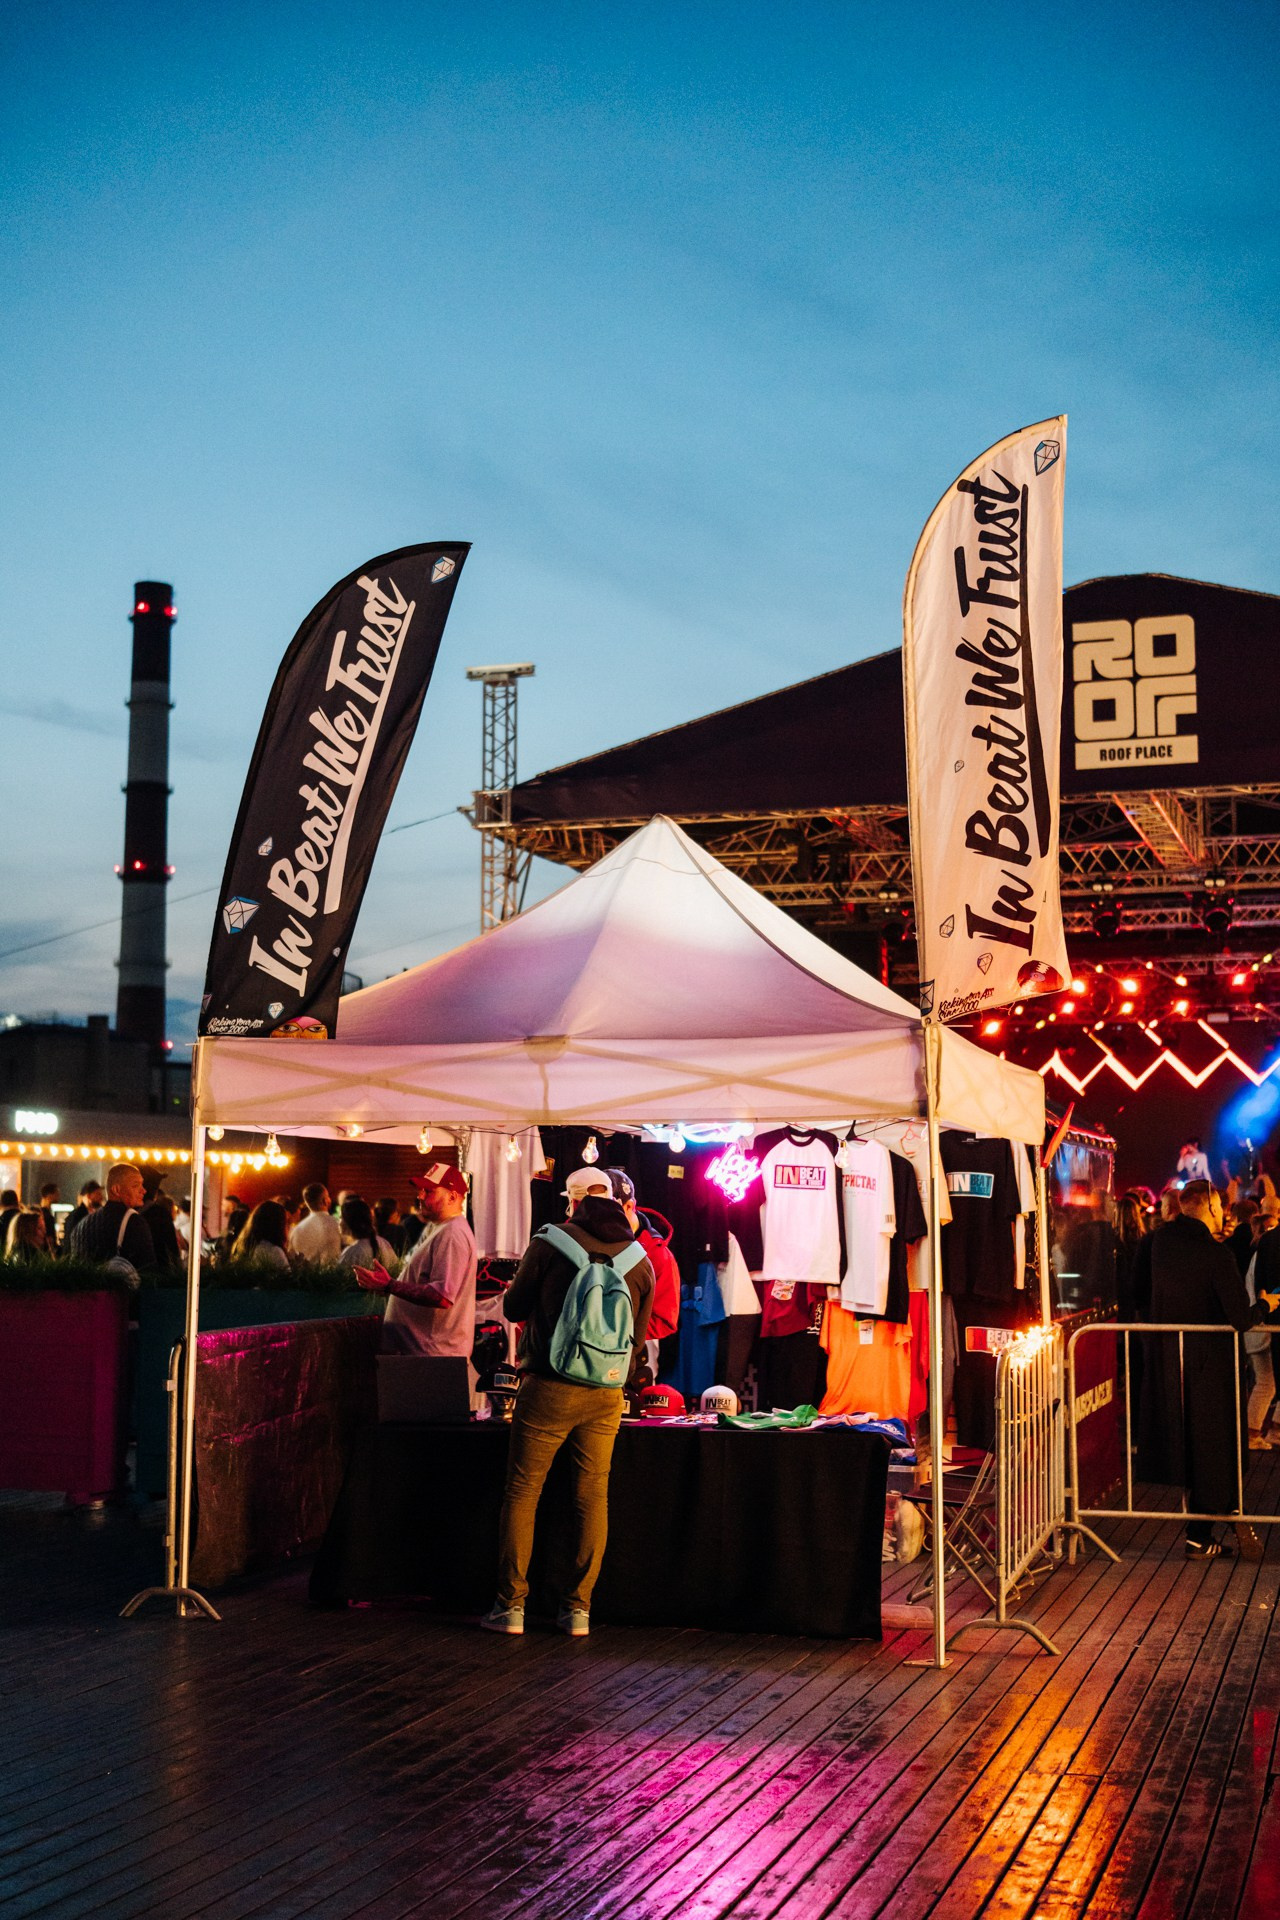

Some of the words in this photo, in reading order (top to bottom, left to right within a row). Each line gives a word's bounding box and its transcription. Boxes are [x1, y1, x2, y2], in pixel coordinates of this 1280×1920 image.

[954, 468, 1021, 617] Trust
[325, 575, 408, 704] Trust
[955, 617, 1024, 709] We
[303, 700, 370, 786] We
[1100, 748, 1132, 761] ROOF
[1135, 745, 1173, 759] PLACE
[965, 715, 1033, 867] Beat
[267, 780, 344, 919] Beat
[249, 914, 313, 997] In
[965, 870, 1036, 956] In
[227, 1025, 249, 1034] 2000
